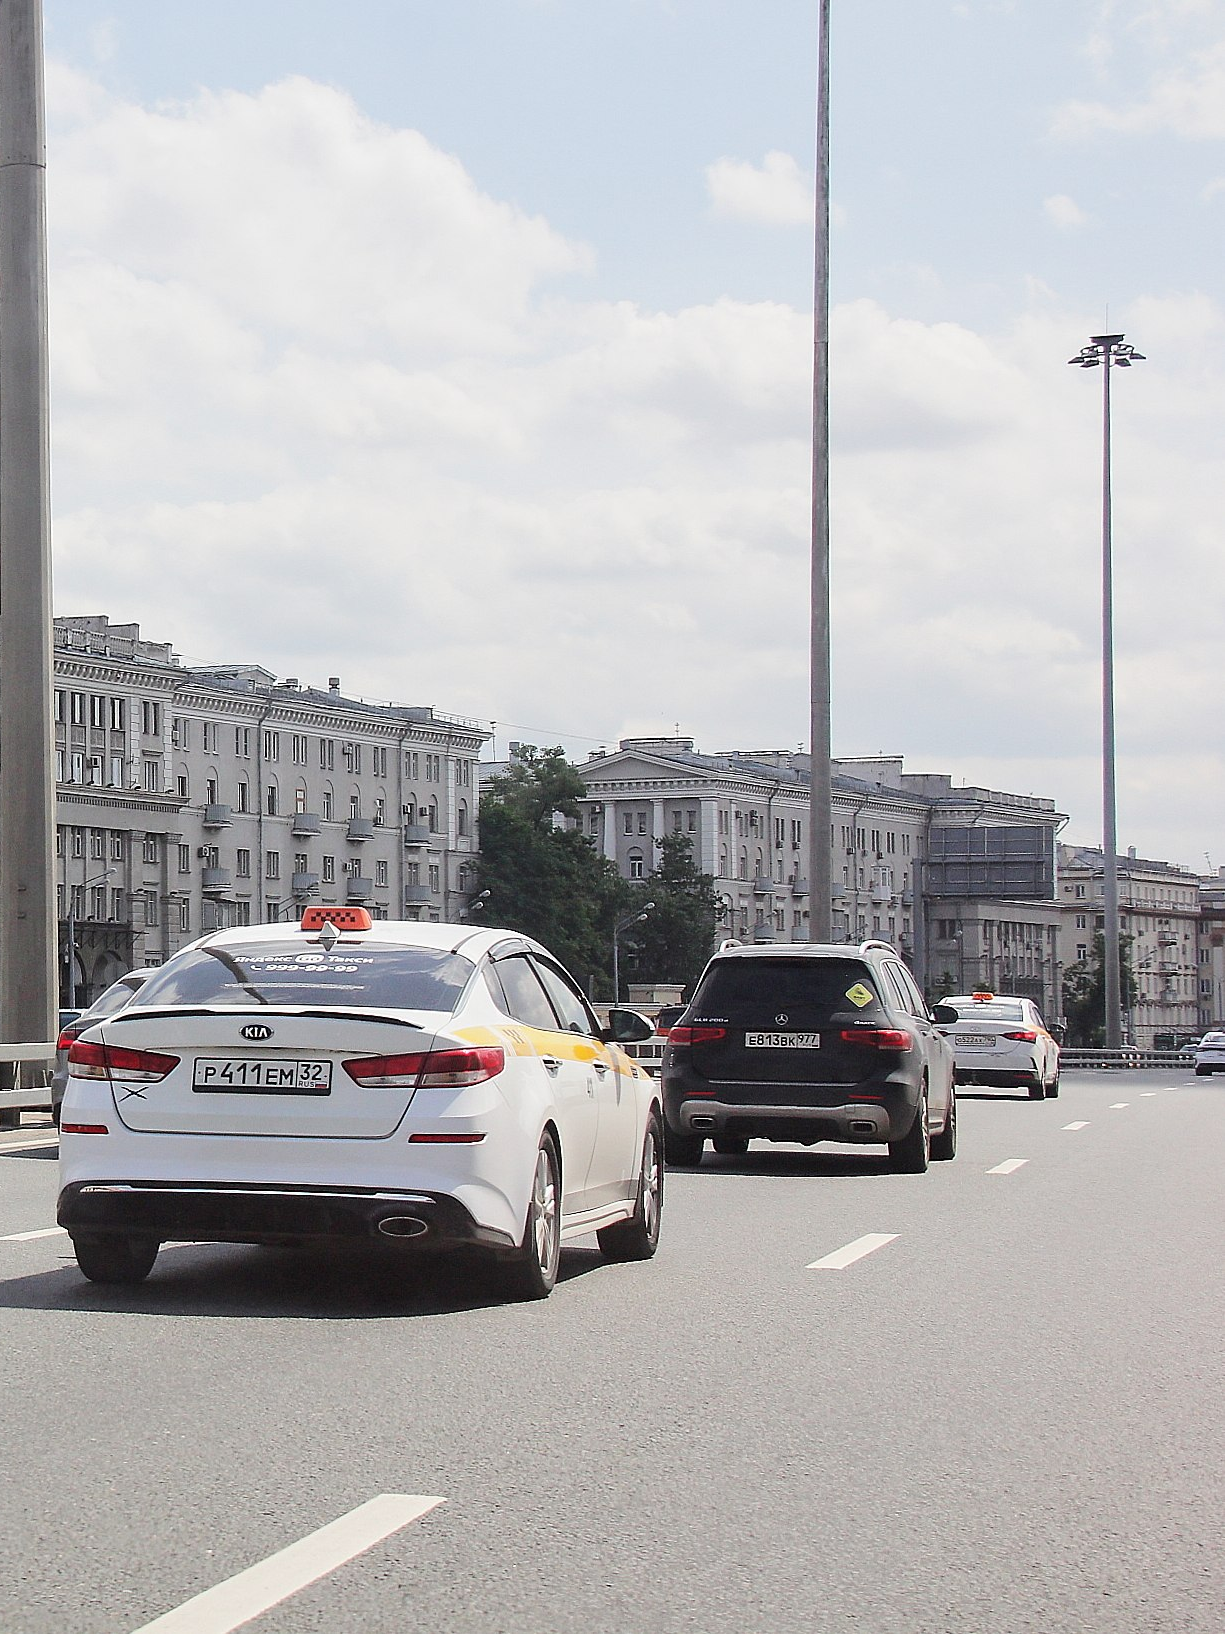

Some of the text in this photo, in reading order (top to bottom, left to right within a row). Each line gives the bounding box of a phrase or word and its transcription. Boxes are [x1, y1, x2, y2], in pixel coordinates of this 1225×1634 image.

[327, 955, 374, 964] Такси
[265, 964, 359, 973] 999-99-99
[245, 1027, 268, 1038] KIA
[300, 1063, 323, 1081] 32
